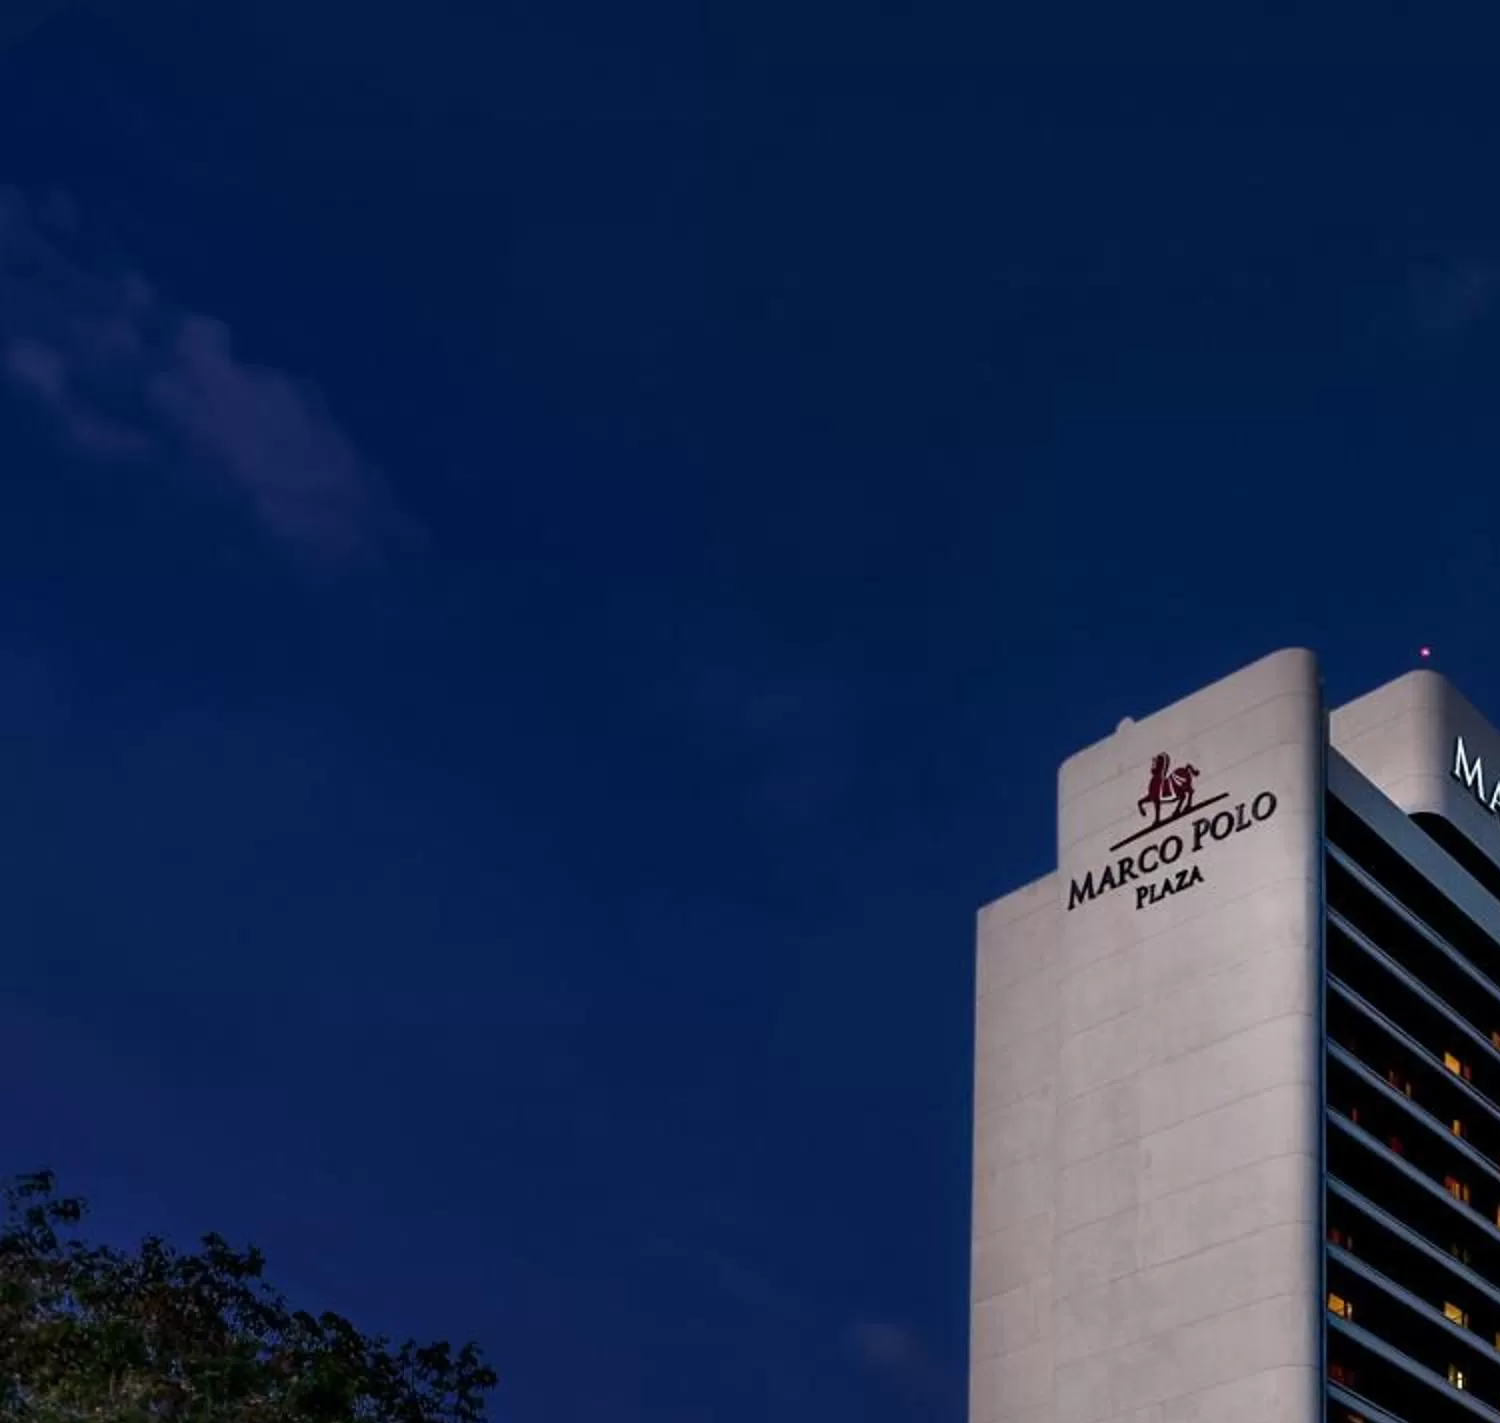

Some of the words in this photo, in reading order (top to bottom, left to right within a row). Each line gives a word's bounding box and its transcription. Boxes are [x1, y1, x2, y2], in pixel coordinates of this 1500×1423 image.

[1068, 835, 1183, 911] MARCO
[1192, 791, 1277, 852] POLO
[1135, 865, 1205, 911] PLAZA
